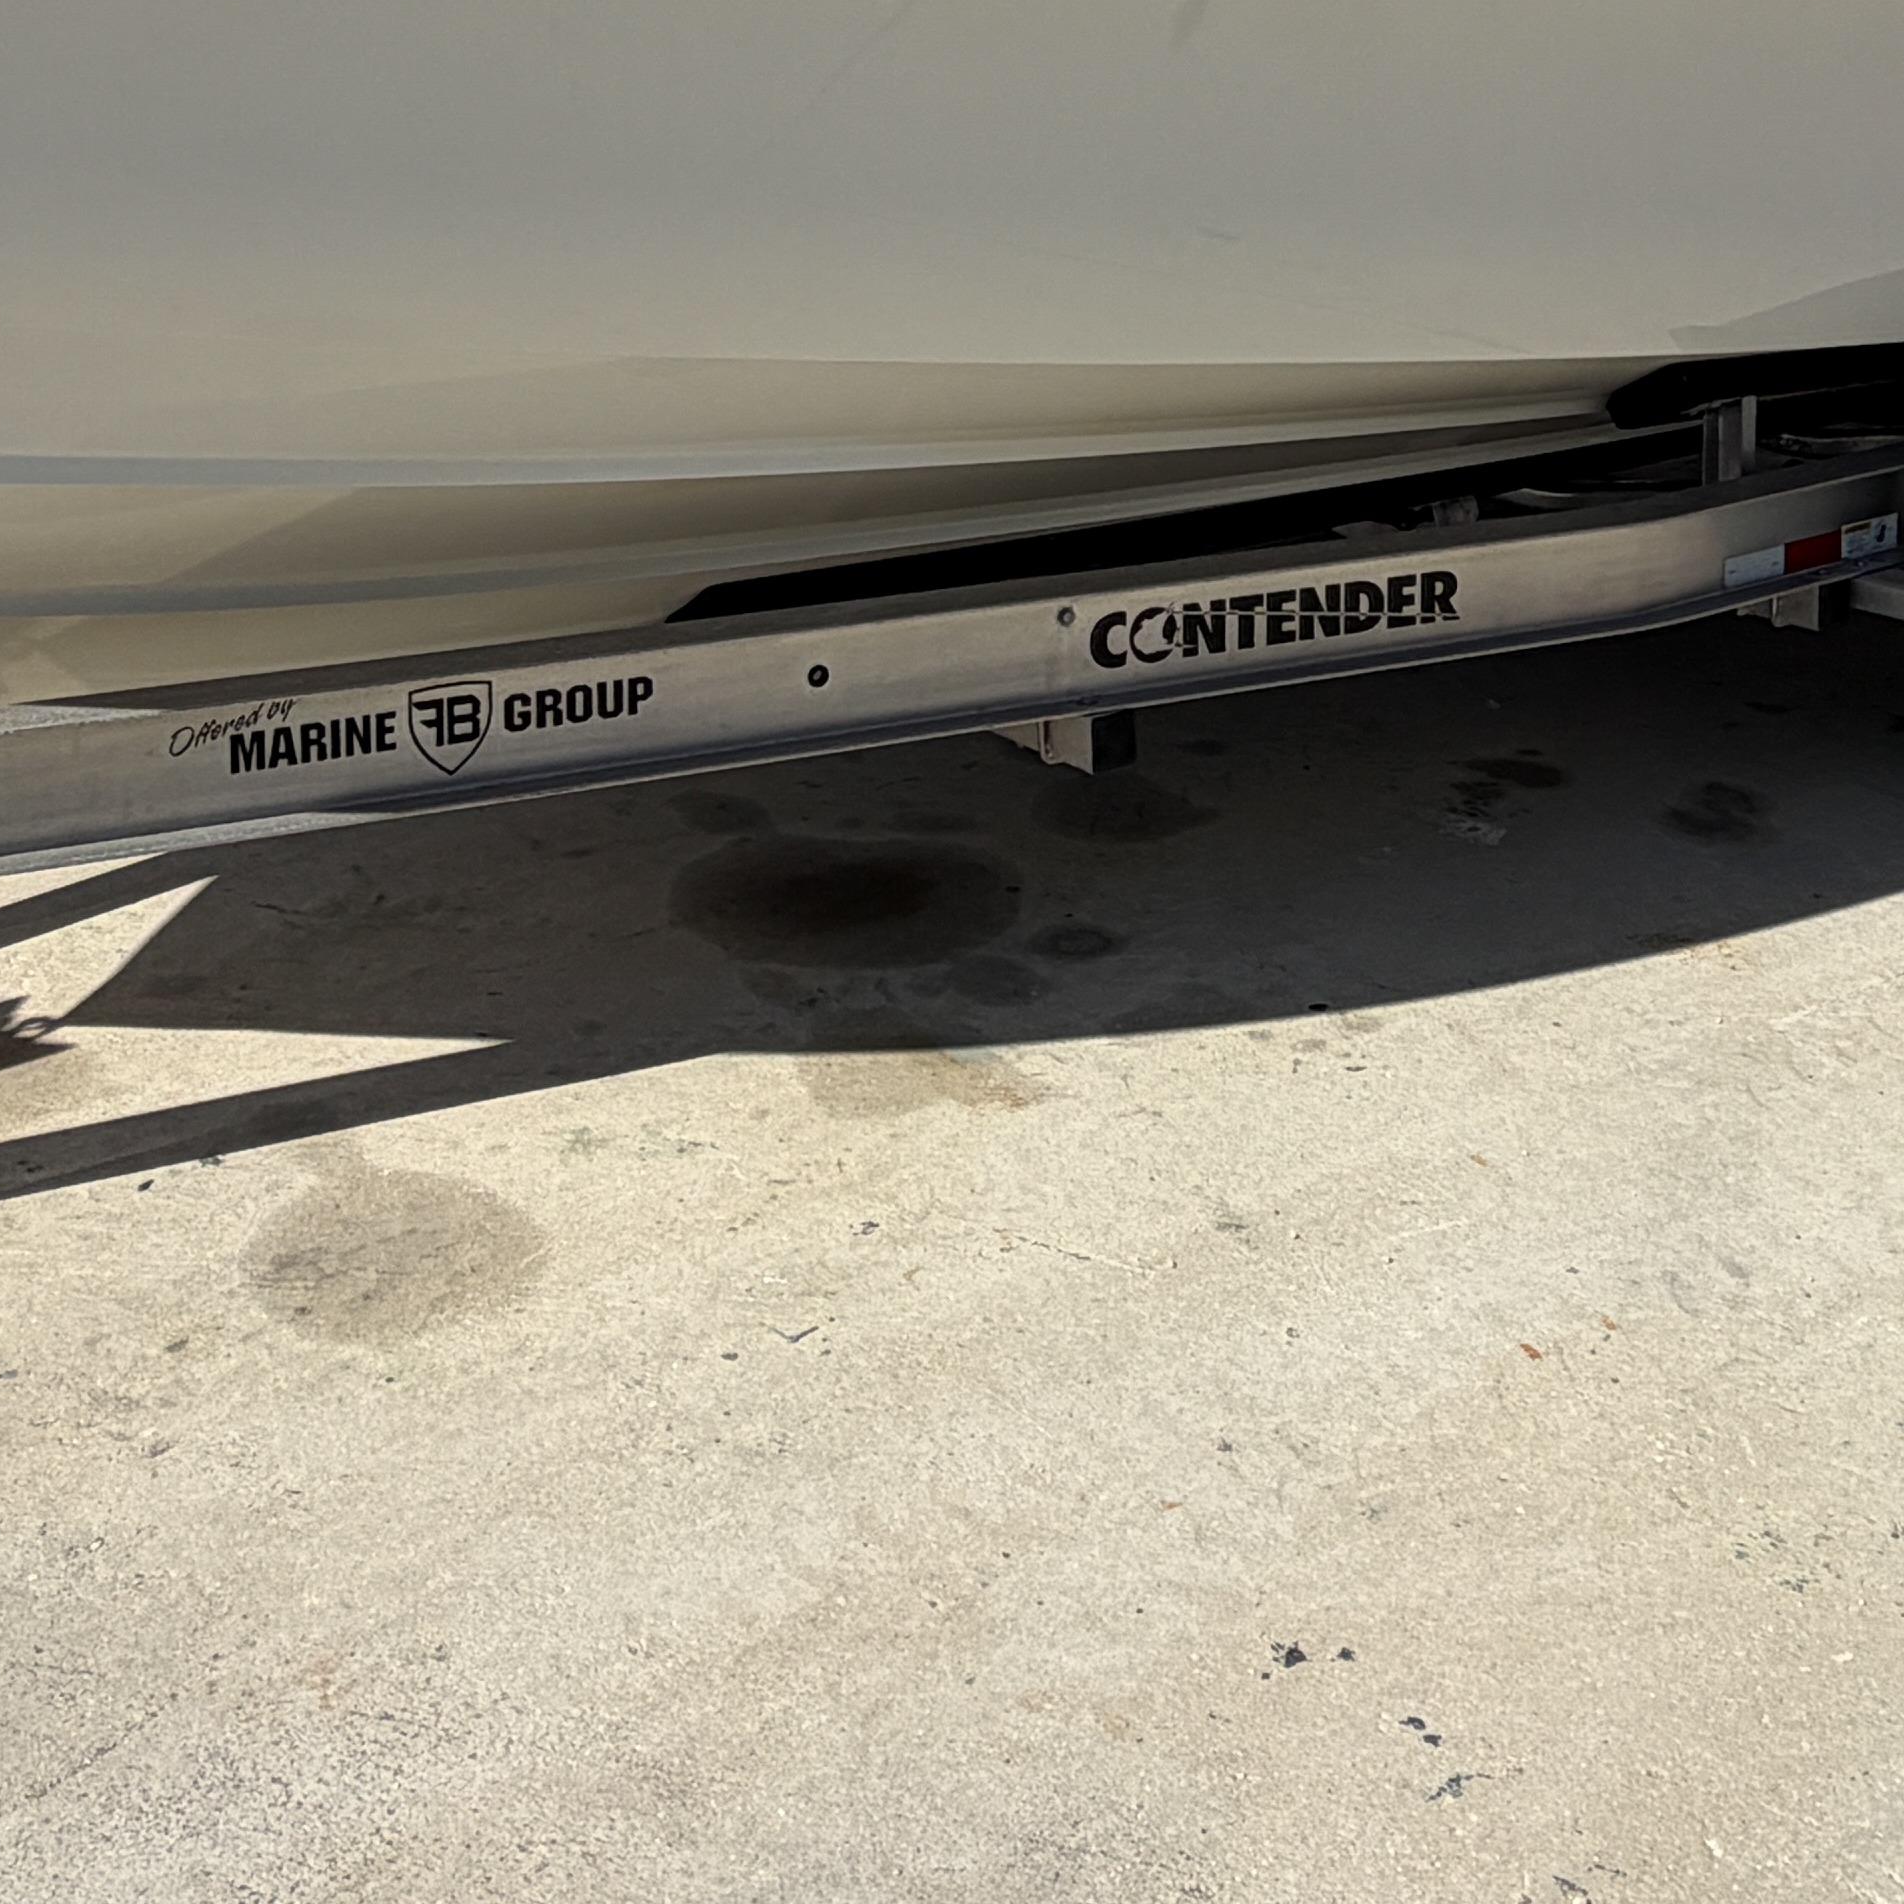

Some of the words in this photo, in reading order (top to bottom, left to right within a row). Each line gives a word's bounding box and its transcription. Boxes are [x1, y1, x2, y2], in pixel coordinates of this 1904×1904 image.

[1090, 570, 1460, 668] CONTENDER
[169, 702, 263, 757] Offered
[266, 698, 297, 724] by
[229, 710, 398, 775] MARINE
[502, 675, 654, 734] GROUP
